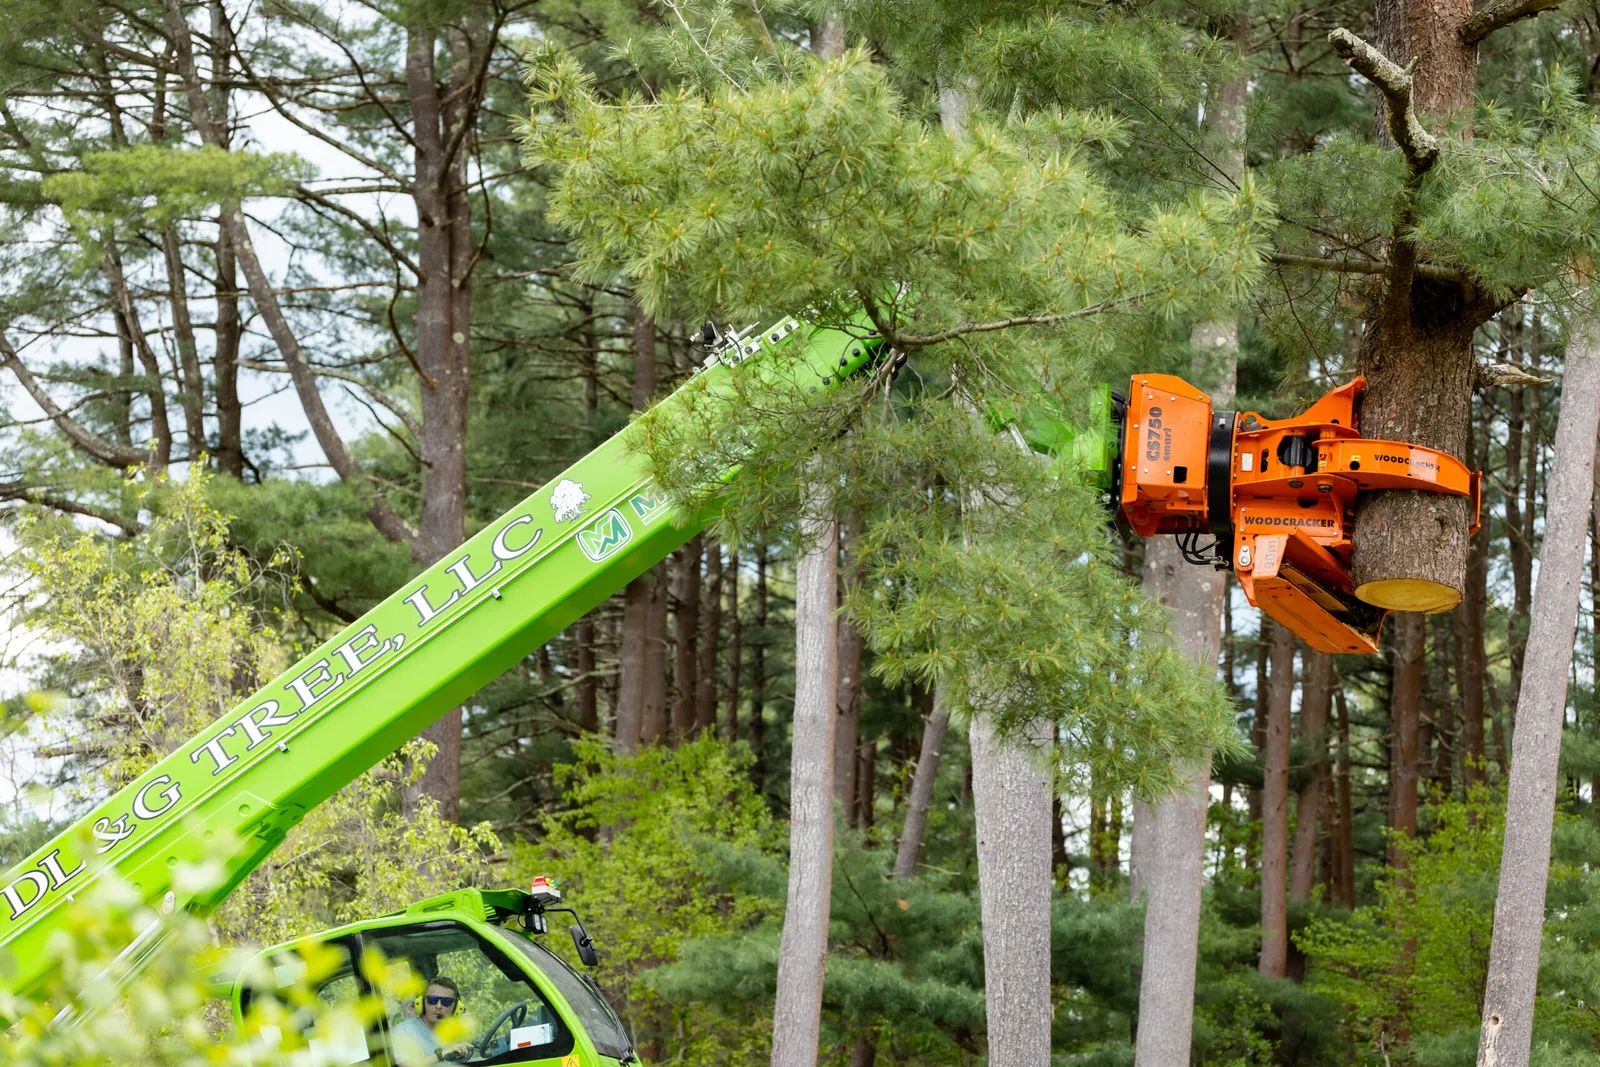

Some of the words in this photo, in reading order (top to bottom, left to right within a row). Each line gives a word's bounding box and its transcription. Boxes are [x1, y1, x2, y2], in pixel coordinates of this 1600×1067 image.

[1146, 406, 1163, 461] CS750
[1163, 427, 1172, 462] smart
[1244, 516, 1335, 528] WOODCRACKER
[0, 848, 87, 921] DL
[191, 624, 406, 776] TREE,
[402, 514, 544, 628] LLC
